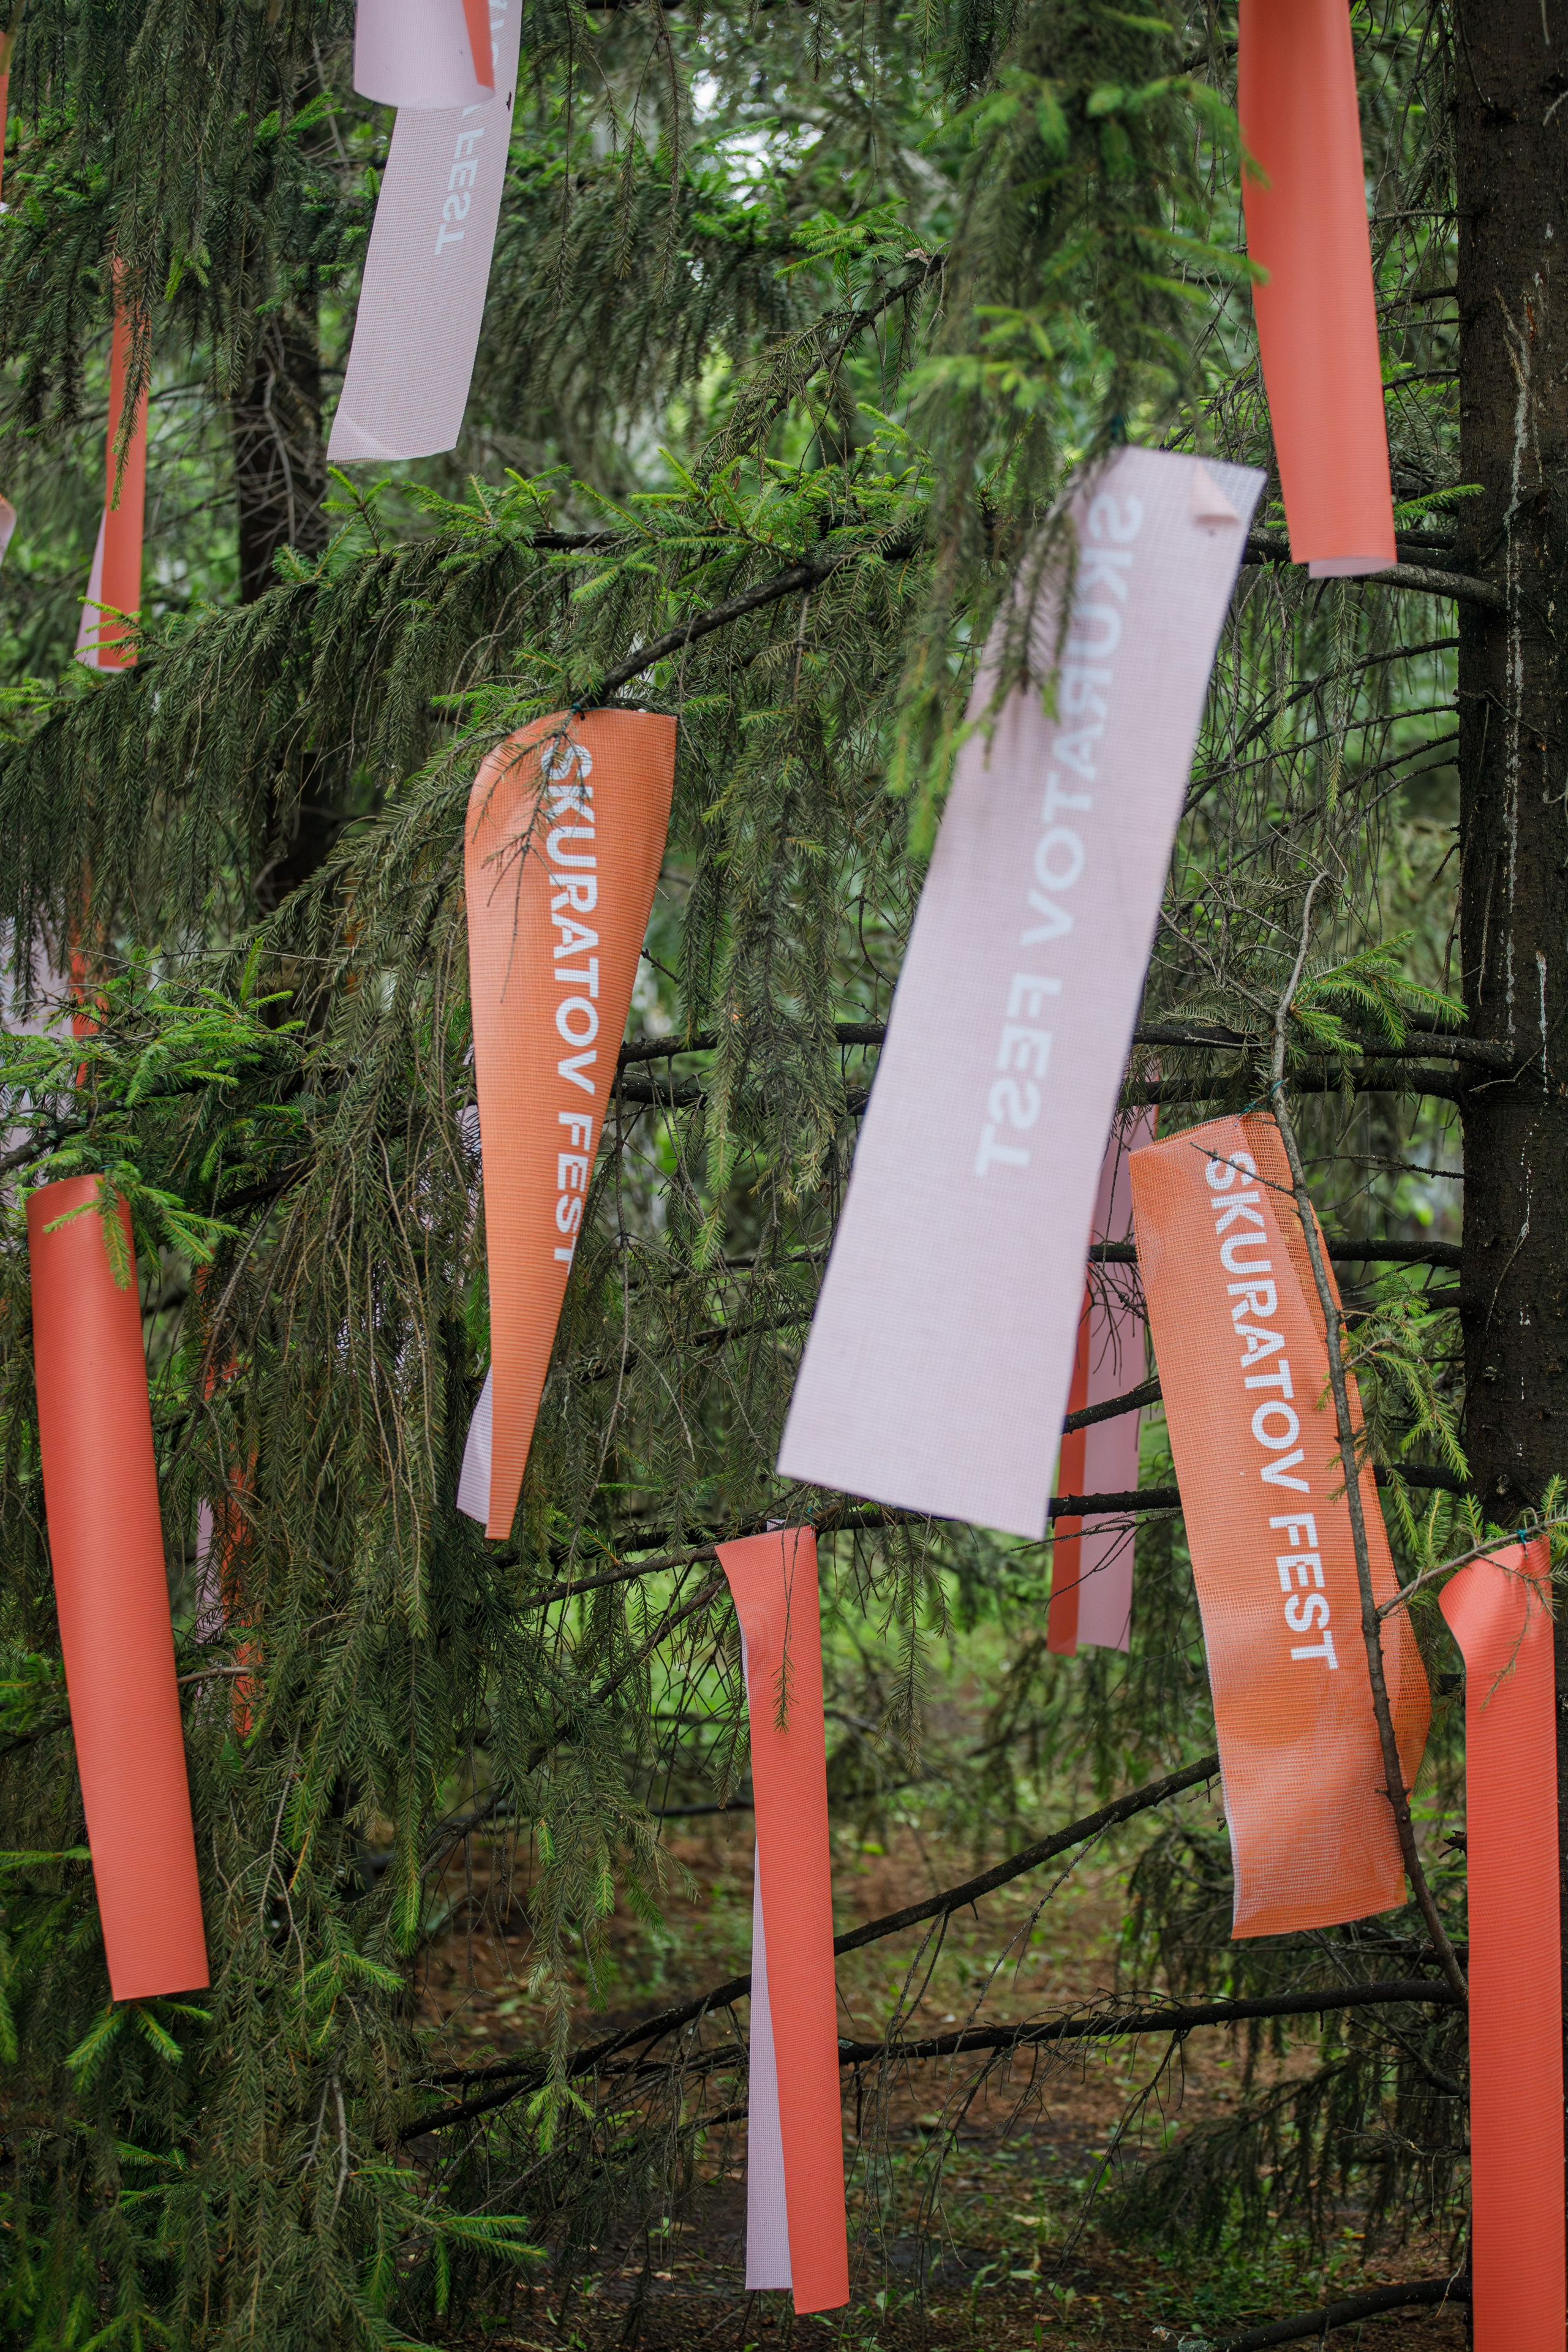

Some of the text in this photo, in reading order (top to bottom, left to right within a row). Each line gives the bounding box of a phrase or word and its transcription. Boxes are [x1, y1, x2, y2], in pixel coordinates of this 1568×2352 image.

[540, 743, 600, 1275] SKURATOV FEST
[1205, 1151, 1339, 1670] SKURATOV FEST
